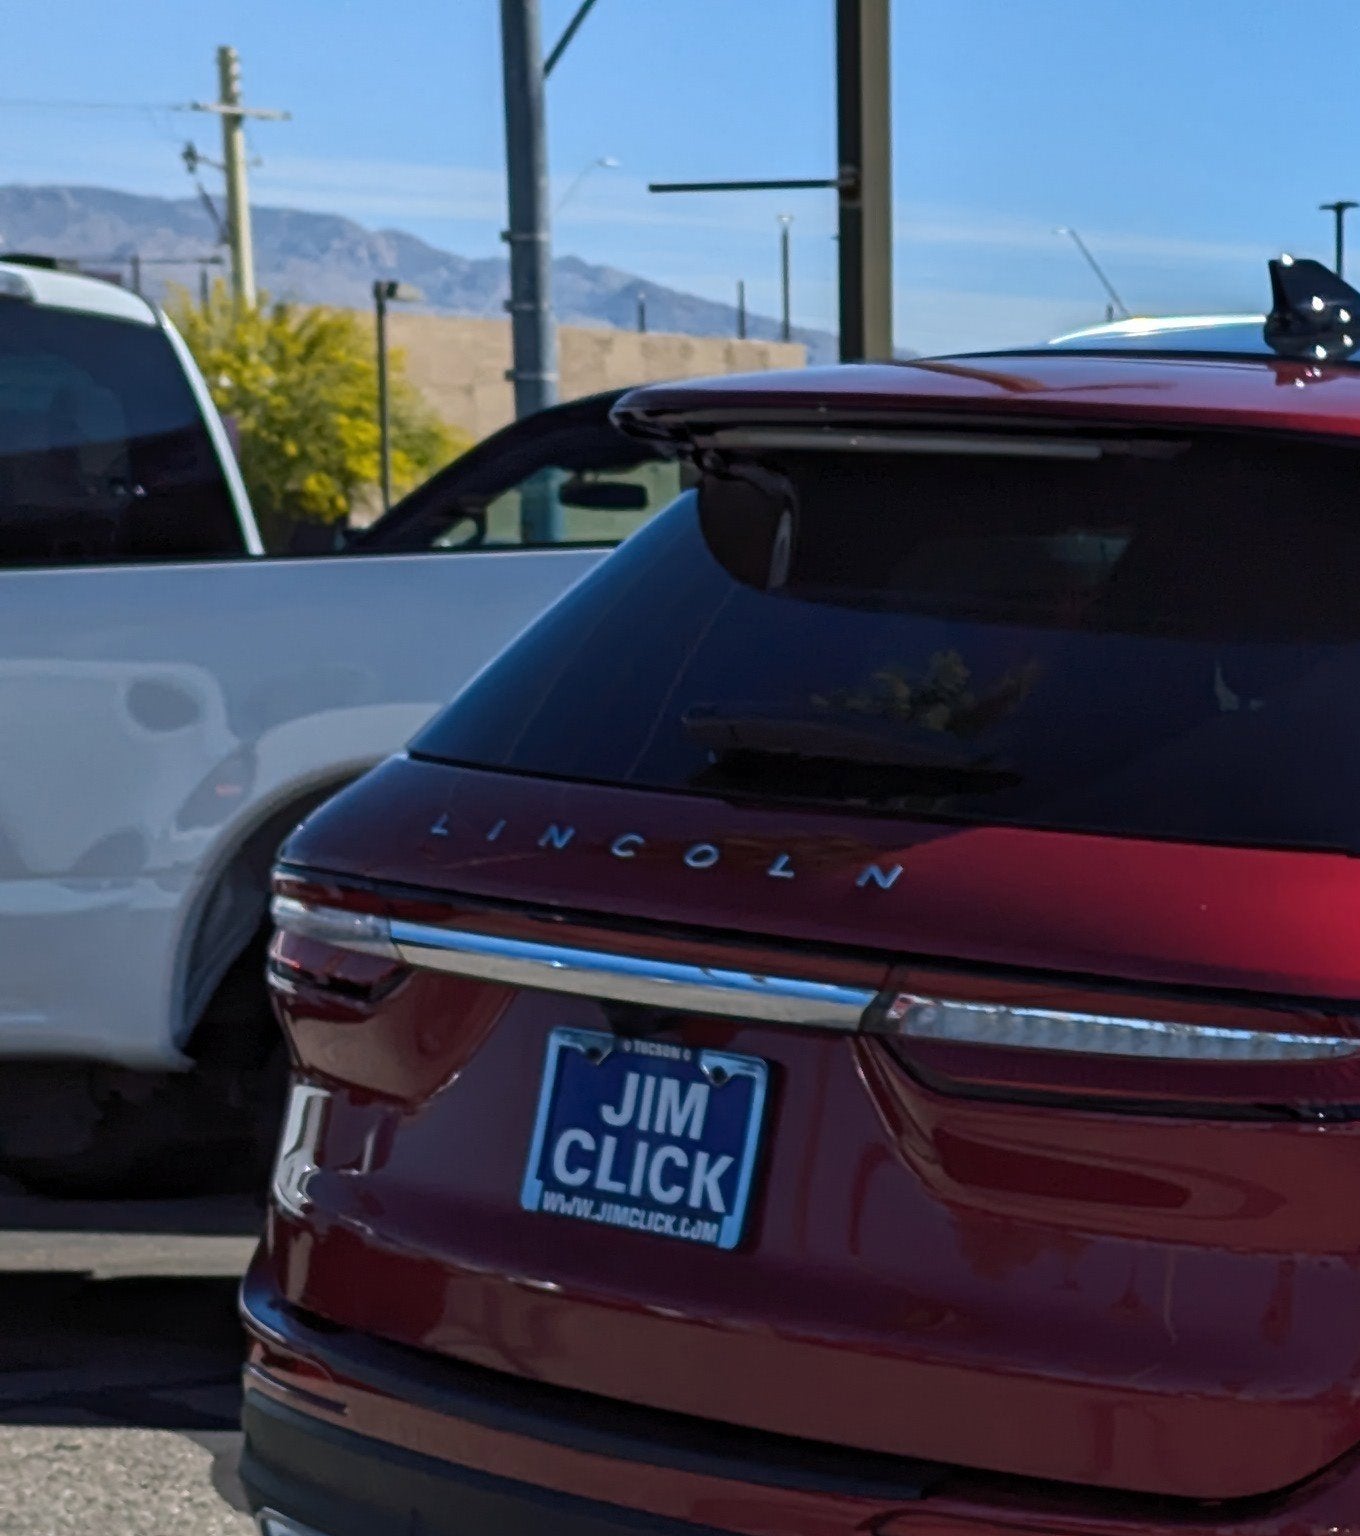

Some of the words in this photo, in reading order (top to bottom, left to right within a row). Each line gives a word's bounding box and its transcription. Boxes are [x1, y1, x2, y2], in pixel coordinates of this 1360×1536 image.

[429, 813, 905, 891] LINCOLN
[633, 1041, 682, 1060] TUCSON
[600, 1072, 711, 1140] JIM
[552, 1127, 735, 1214] CLICK
[542, 1189, 720, 1243] WWW.JIMCLICK.COM
